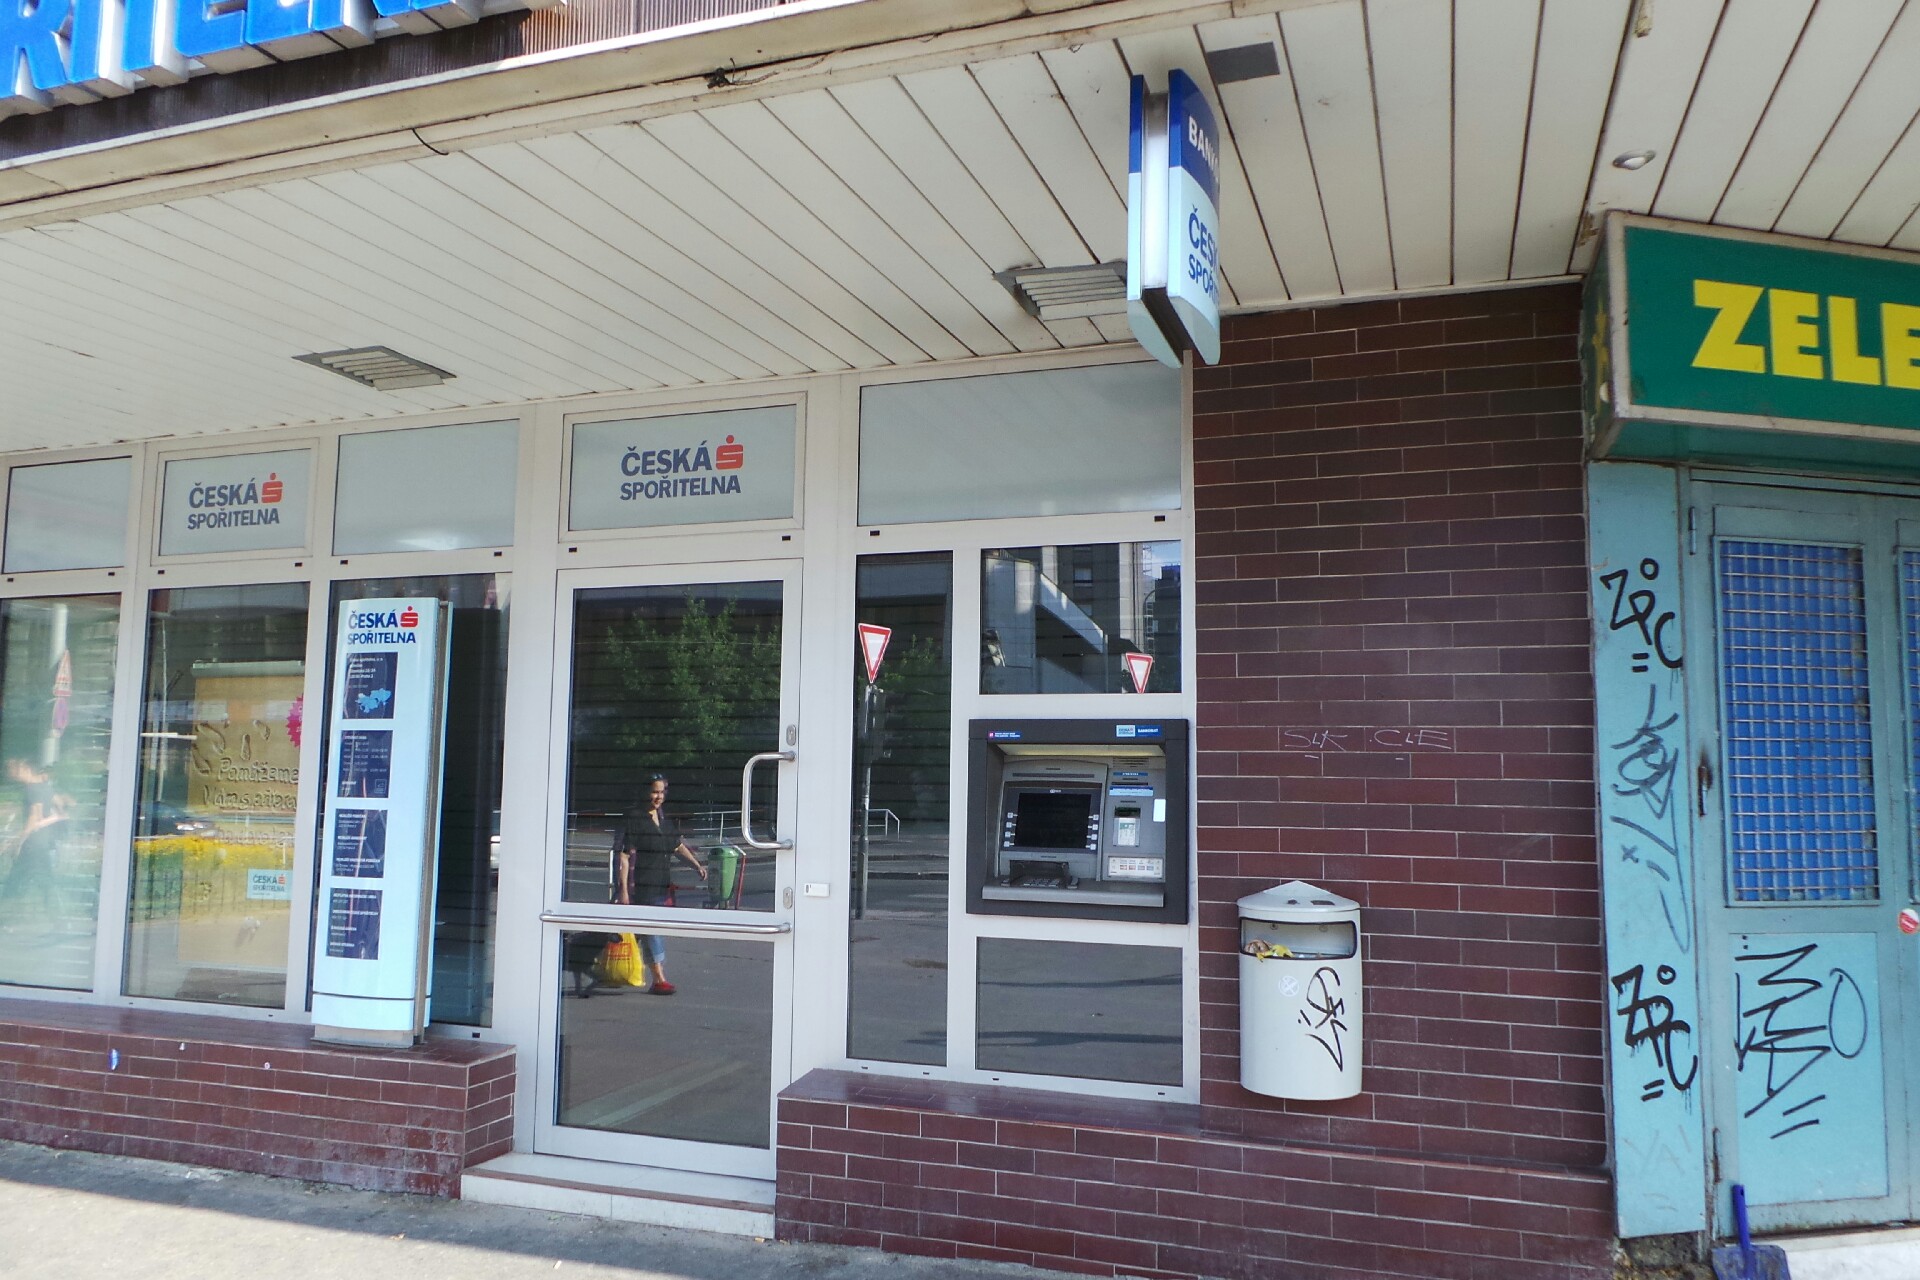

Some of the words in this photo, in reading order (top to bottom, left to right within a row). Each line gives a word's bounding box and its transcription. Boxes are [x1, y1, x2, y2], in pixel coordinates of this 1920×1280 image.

[621, 440, 712, 476] ČESKÁ
[189, 477, 259, 508] ČESKÁ
[620, 475, 741, 501] SPOŘITELNA
[187, 508, 280, 530] SPOŘITELNA
[348, 609, 399, 630] ČESKÁ
[347, 630, 416, 645] SPOŘITELNA
